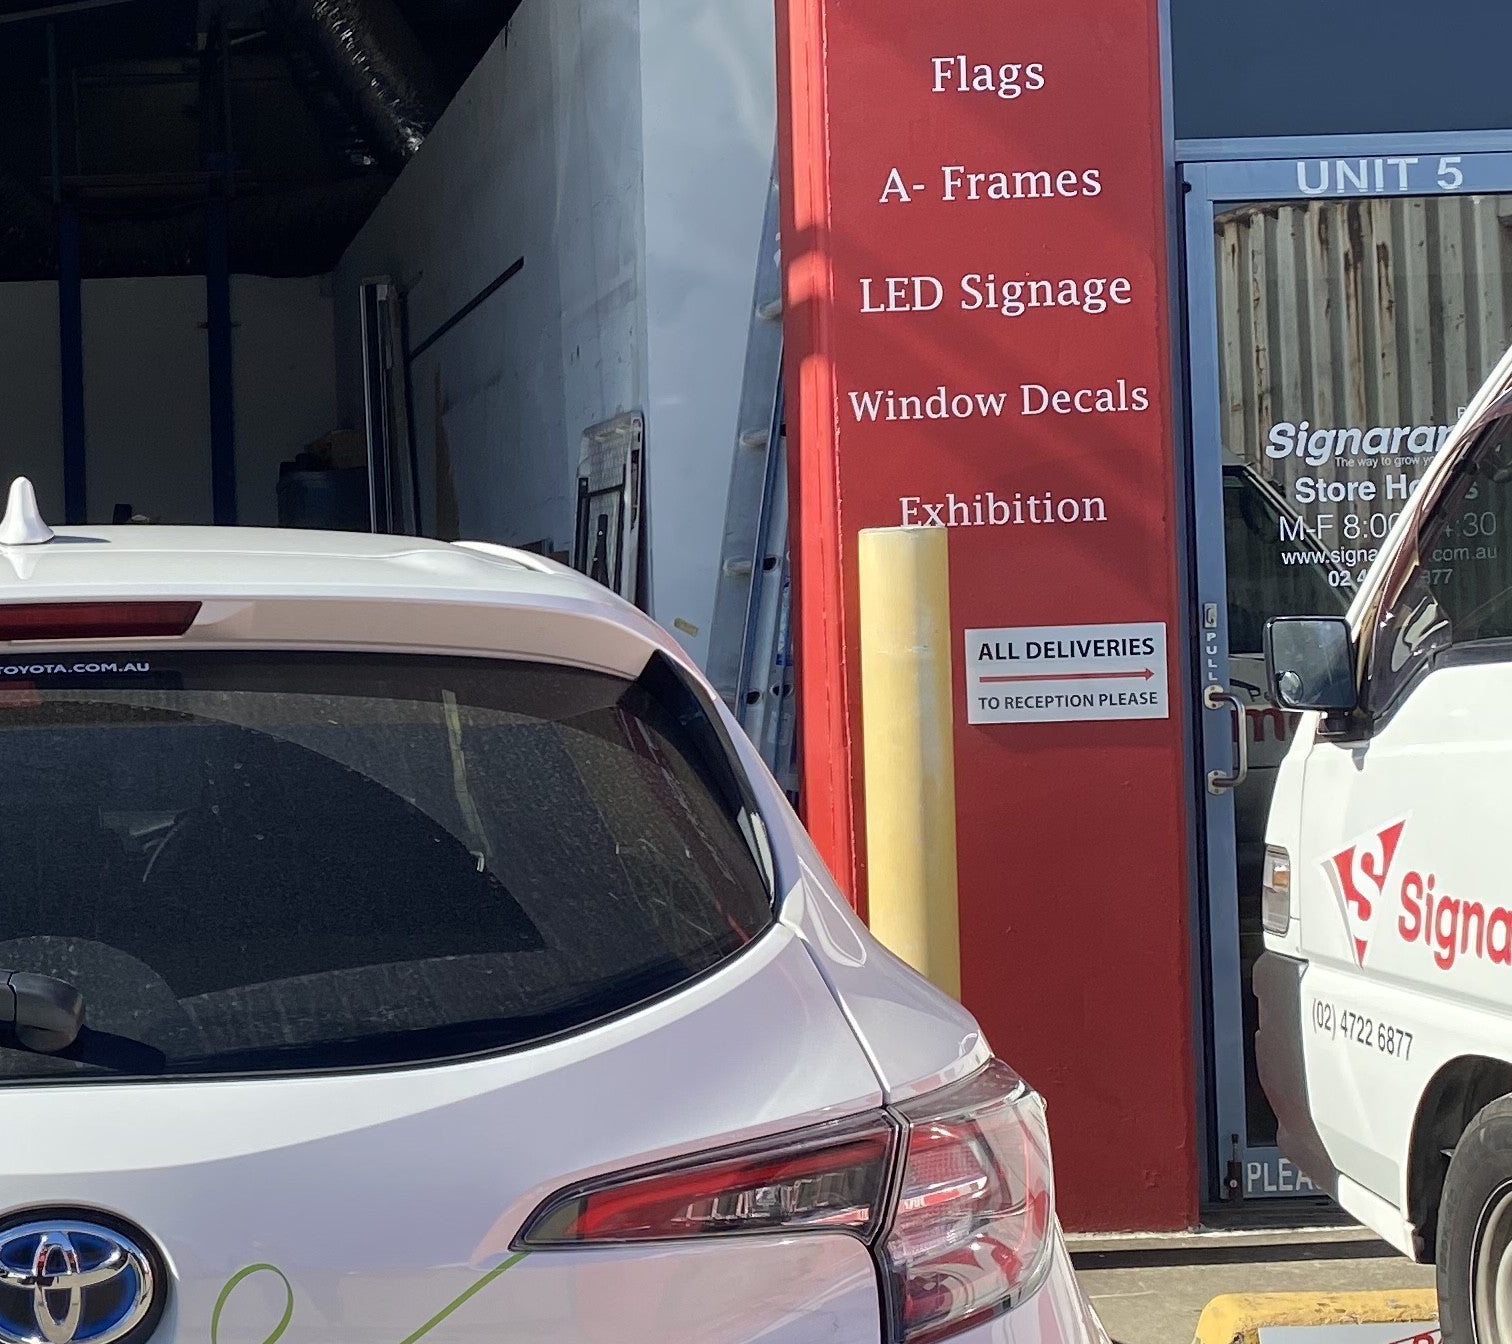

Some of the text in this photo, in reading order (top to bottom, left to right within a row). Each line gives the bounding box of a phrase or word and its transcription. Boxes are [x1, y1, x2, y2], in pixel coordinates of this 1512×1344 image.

[931, 55, 1045, 99] Flags
[878, 163, 1102, 203] A- Frames
[1296, 156, 1464, 195] UNIT 5
[859, 272, 1131, 317] LED Signage
[847, 379, 1149, 422] Window Decals
[1335, 456, 1355, 467] The
[1357, 457, 1378, 469] way
[1381, 456, 1391, 467] to
[1394, 457, 1420, 468] grow
[1294, 476, 1377, 504] Store
[899, 492, 1108, 528] Exhibition
[1278, 513, 1334, 542] M-F
[1328, 570, 1352, 587] 02
[978, 637, 1155, 661] ALL DELIVERIES
[1206, 632, 1218, 681] PULL
[979, 691, 1159, 710] TO RECEPTION PLEASE
[1312, 998, 1414, 1061] (02) 4722 6877
[1247, 1158, 1321, 1192] PLEA
